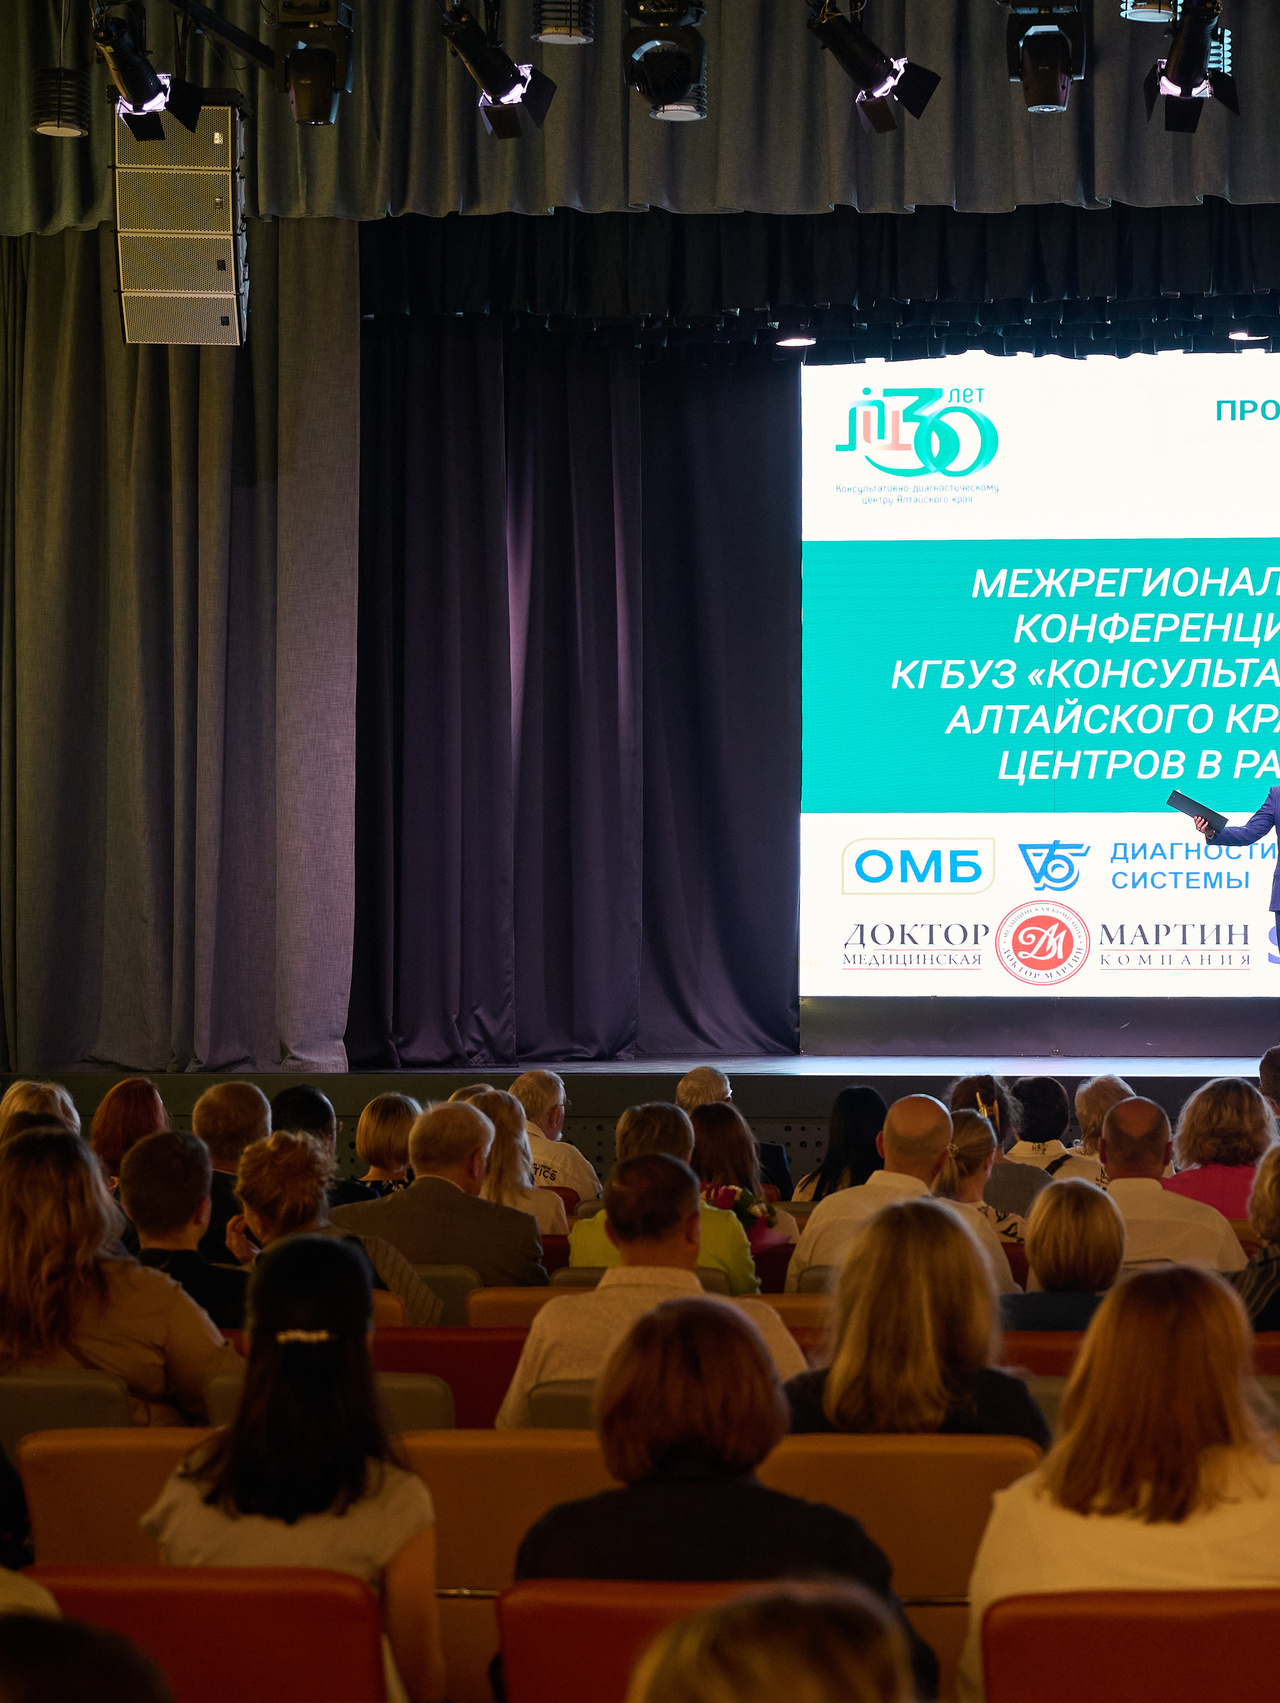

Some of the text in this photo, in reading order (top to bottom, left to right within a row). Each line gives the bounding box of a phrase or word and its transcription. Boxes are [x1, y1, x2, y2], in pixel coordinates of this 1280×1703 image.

[948, 388, 985, 403] лет
[836, 484, 999, 495] Консультативно-диагностическому
[862, 496, 893, 505] центру
[952, 496, 973, 504] края
[892, 658, 1017, 690] КГБУЗ
[945, 697, 1214, 734] АЛТАЙСКОГО
[999, 749, 1186, 785] ЦЕНТРОВ
[1197, 749, 1223, 780] В
[855, 849, 982, 883] ОМБ
[1112, 871, 1249, 889] СИСТЕМЫ
[844, 924, 990, 950] ДОКТОР
[1099, 924, 1250, 946] МАРТИН
[842, 954, 981, 966] МЕДИЦИНСКАЯ
[1100, 955, 1250, 965] КОМПАНИЯ
[533, 1166, 556, 1181] TICS
